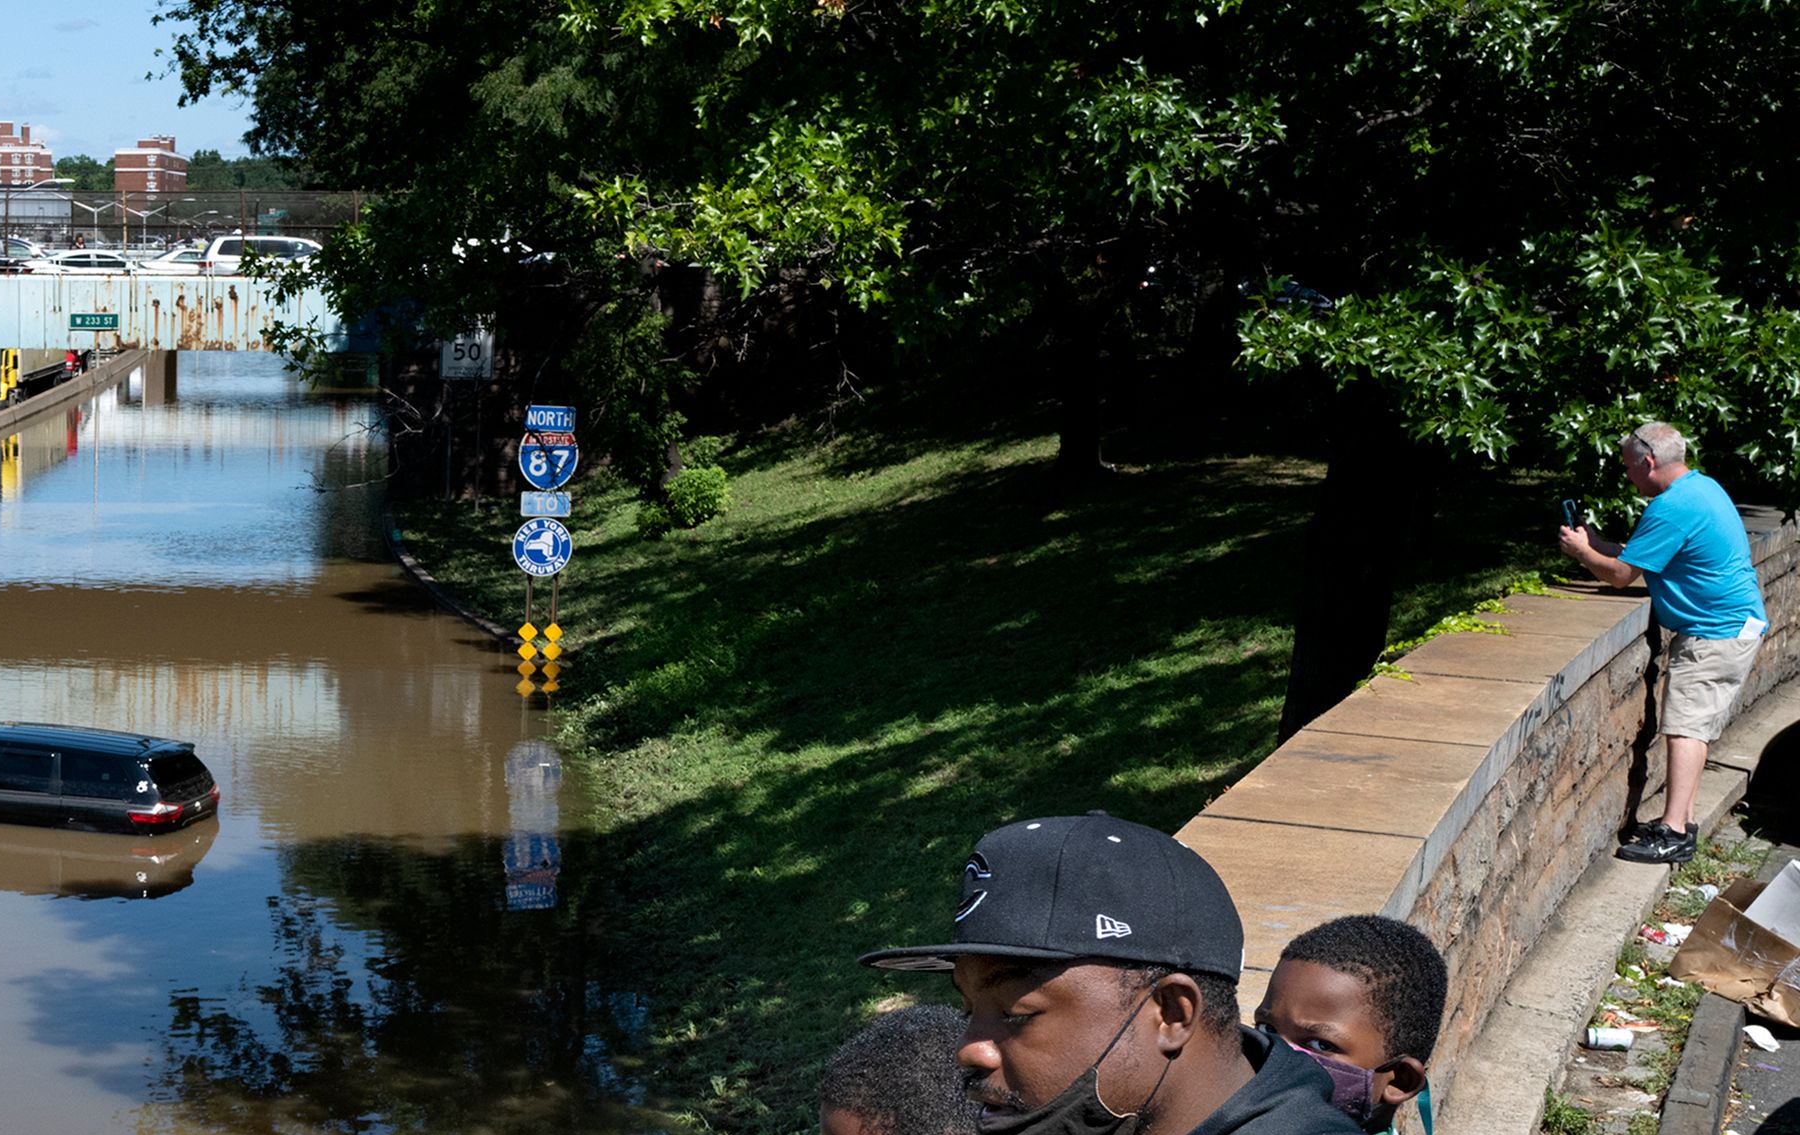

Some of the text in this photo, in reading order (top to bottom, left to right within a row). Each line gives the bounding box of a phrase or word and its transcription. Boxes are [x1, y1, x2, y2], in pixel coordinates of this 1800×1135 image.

[75, 316, 113, 325] W 233 ST
[453, 343, 481, 361] 50
[527, 410, 573, 427] NORTH
[529, 449, 570, 477] 87
[534, 496, 558, 512] TO
[517, 519, 569, 543] NEW YORK
[518, 554, 566, 575] THRUWAY
